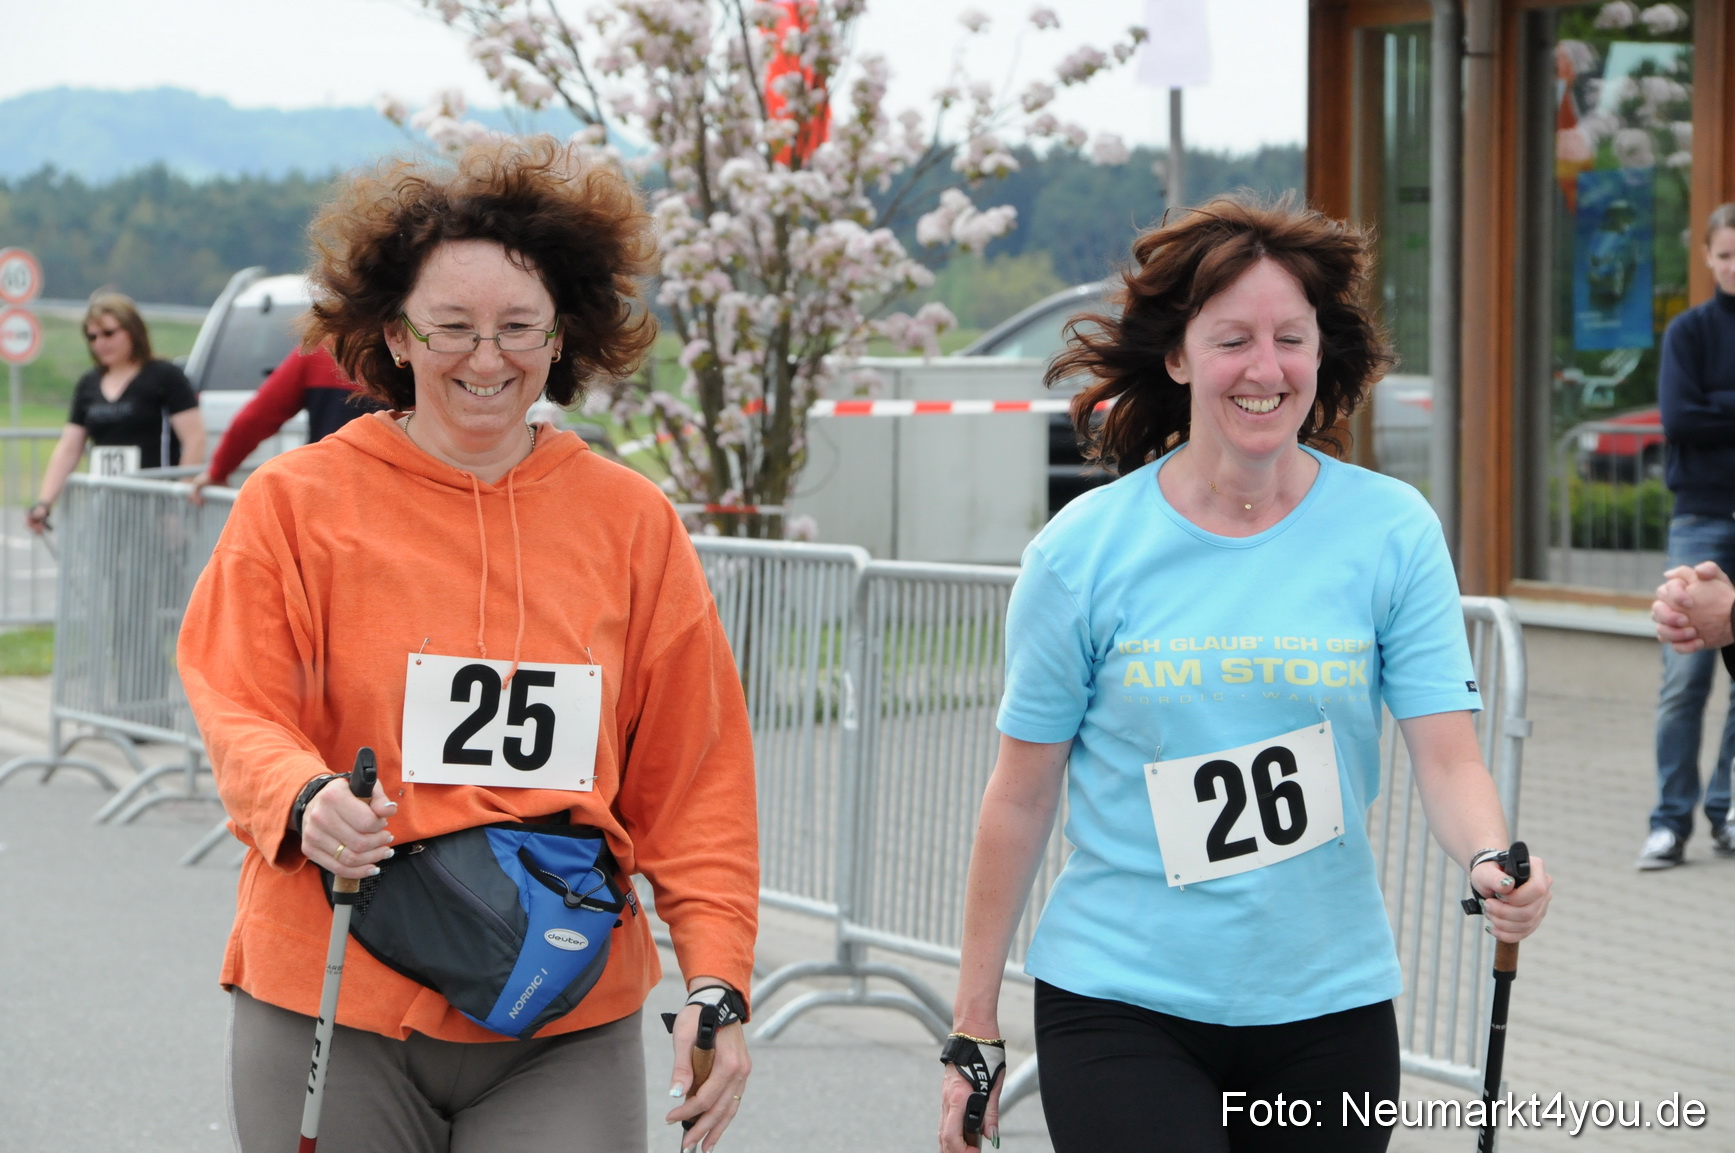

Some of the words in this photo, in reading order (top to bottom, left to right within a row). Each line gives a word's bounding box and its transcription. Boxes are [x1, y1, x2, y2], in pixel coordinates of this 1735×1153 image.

[1118, 640, 1160, 654] ICH
[1274, 636, 1318, 652] ICH
[1123, 659, 1202, 688] AM
[1221, 657, 1368, 687] STOCK
[1123, 692, 1224, 704] NORDIC
[442, 664, 556, 771] 25
[1194, 746, 1307, 862] 26
[547, 933, 586, 946] deuter
[508, 975, 543, 1019] NORDIC
[973, 1063, 988, 1096] LEKI
